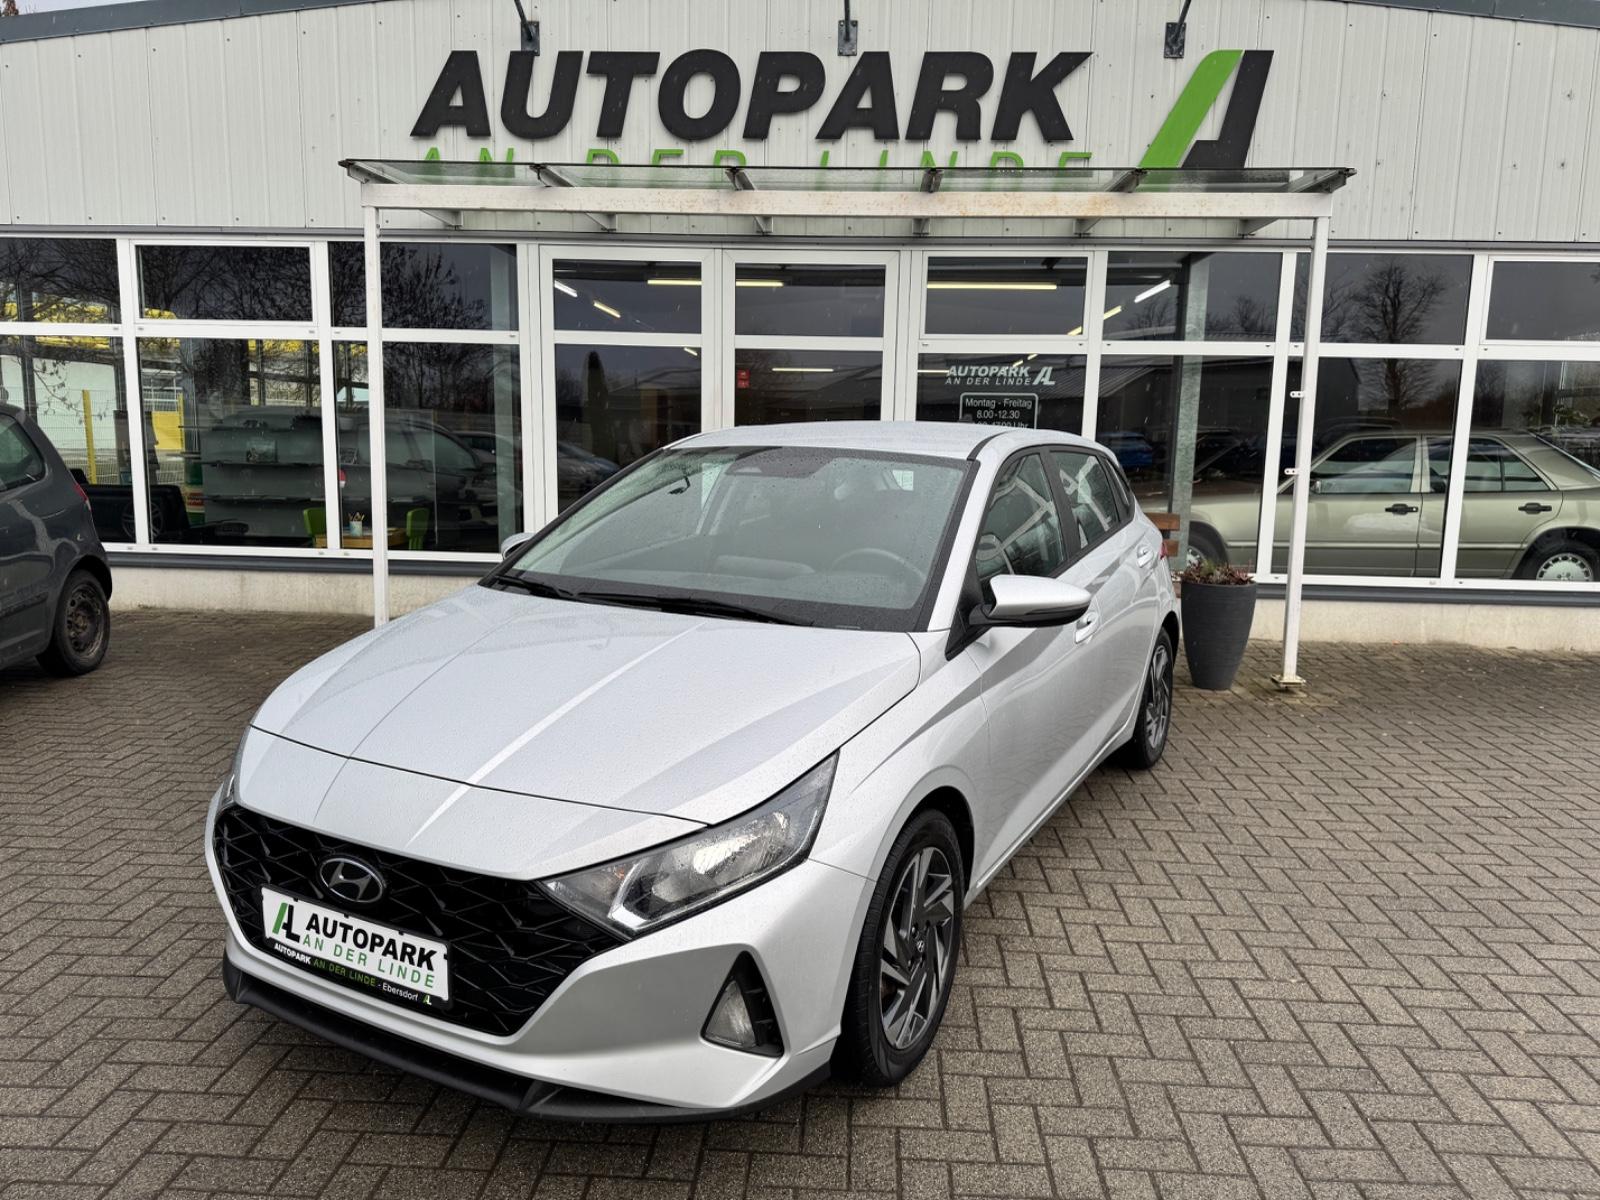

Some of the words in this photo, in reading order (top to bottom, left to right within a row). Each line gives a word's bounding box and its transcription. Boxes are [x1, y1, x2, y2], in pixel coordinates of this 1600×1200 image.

[410, 49, 1094, 140] AUTOPARK
[945, 377, 960, 385] AN
[966, 377, 990, 385] DER
[995, 377, 1031, 386] LINDE
[946, 365, 1031, 377] AUTOPARK
[965, 398, 996, 409] Montag
[1003, 398, 1033, 410] Freitag
[303, 933, 325, 951] AN
[333, 944, 368, 967] DER
[377, 958, 435, 988] LINDE
[305, 913, 437, 971] AUTOPARK
[274, 943, 312, 965] AUTOPARK
[313, 959, 326, 969] AN
[328, 963, 346, 977] DER
[348, 970, 376, 987] LINDE
[382, 982, 419, 1001] Ebersdorf
